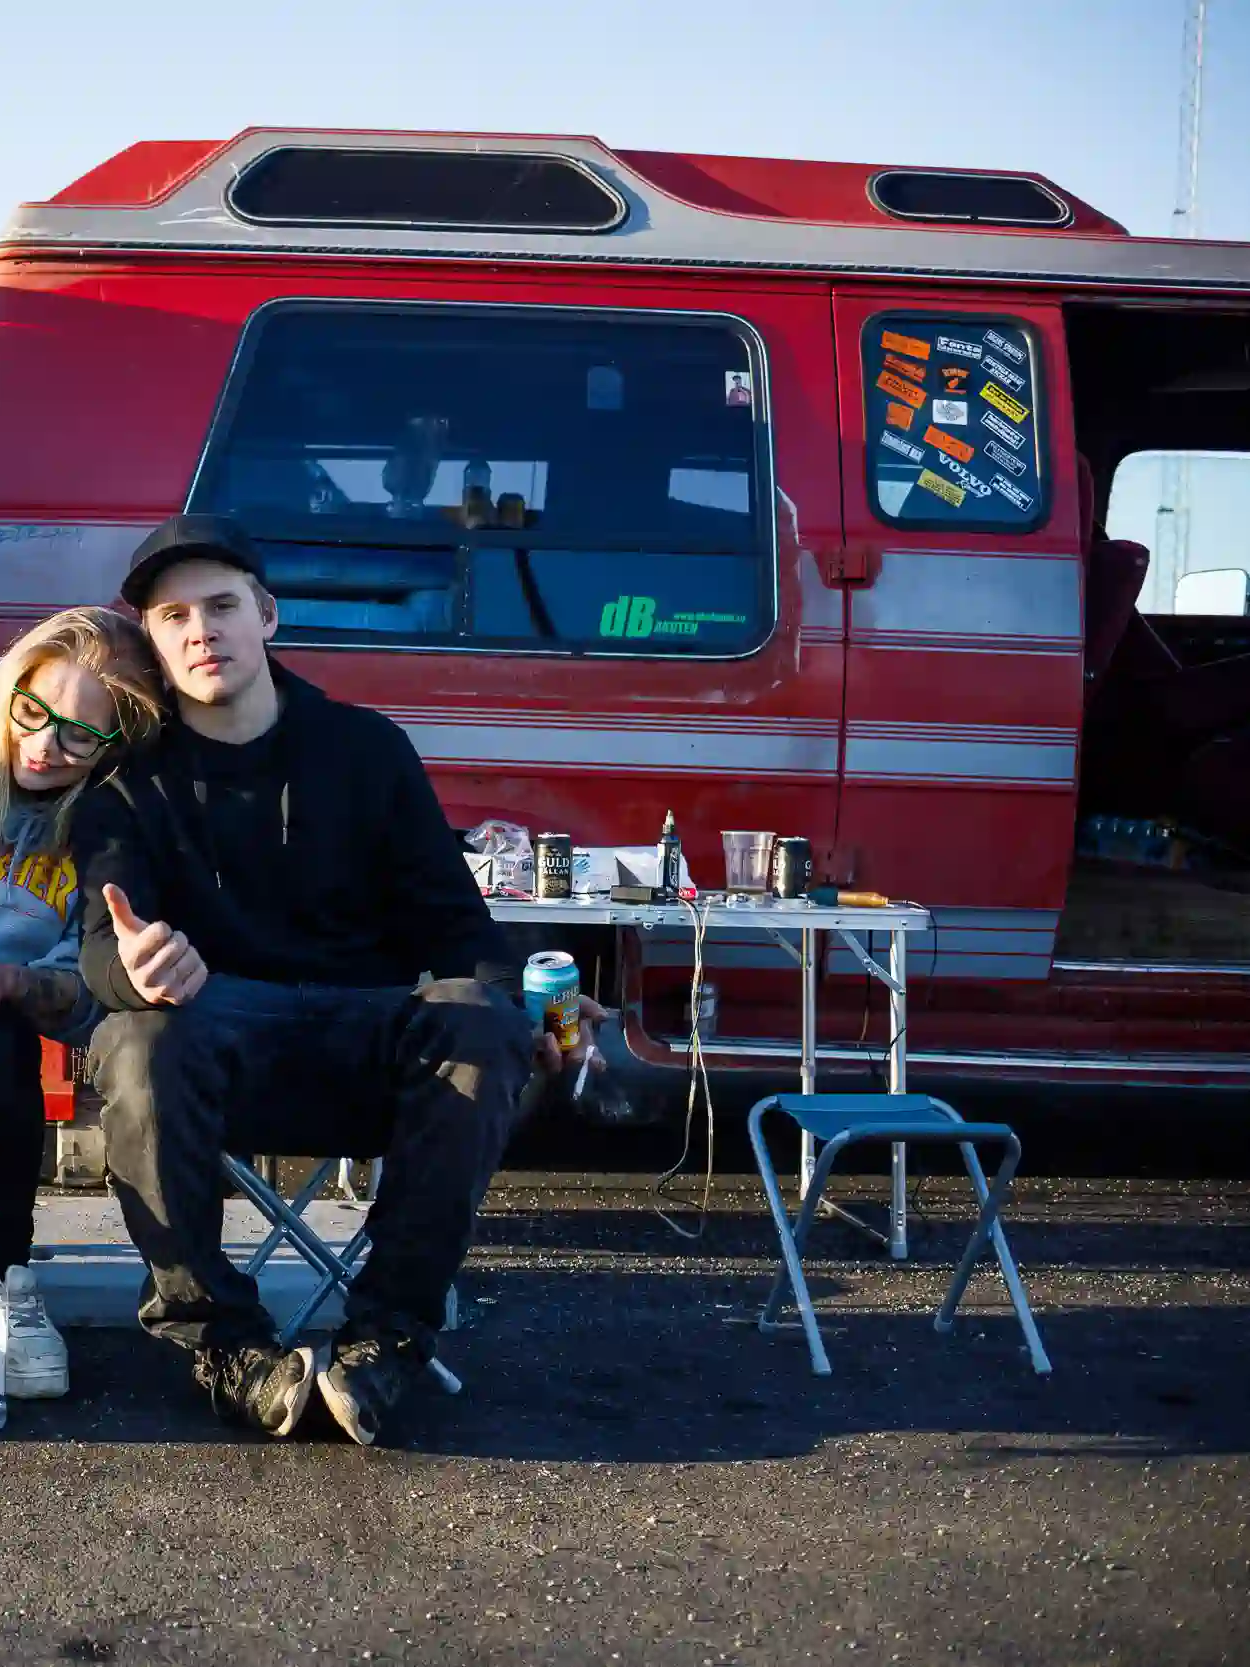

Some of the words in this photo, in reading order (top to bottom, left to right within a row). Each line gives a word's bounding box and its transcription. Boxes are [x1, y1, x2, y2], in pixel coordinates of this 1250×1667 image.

[938, 451, 992, 496] VOLVO
[600, 596, 656, 637] dB
[538, 857, 570, 868] GULD
